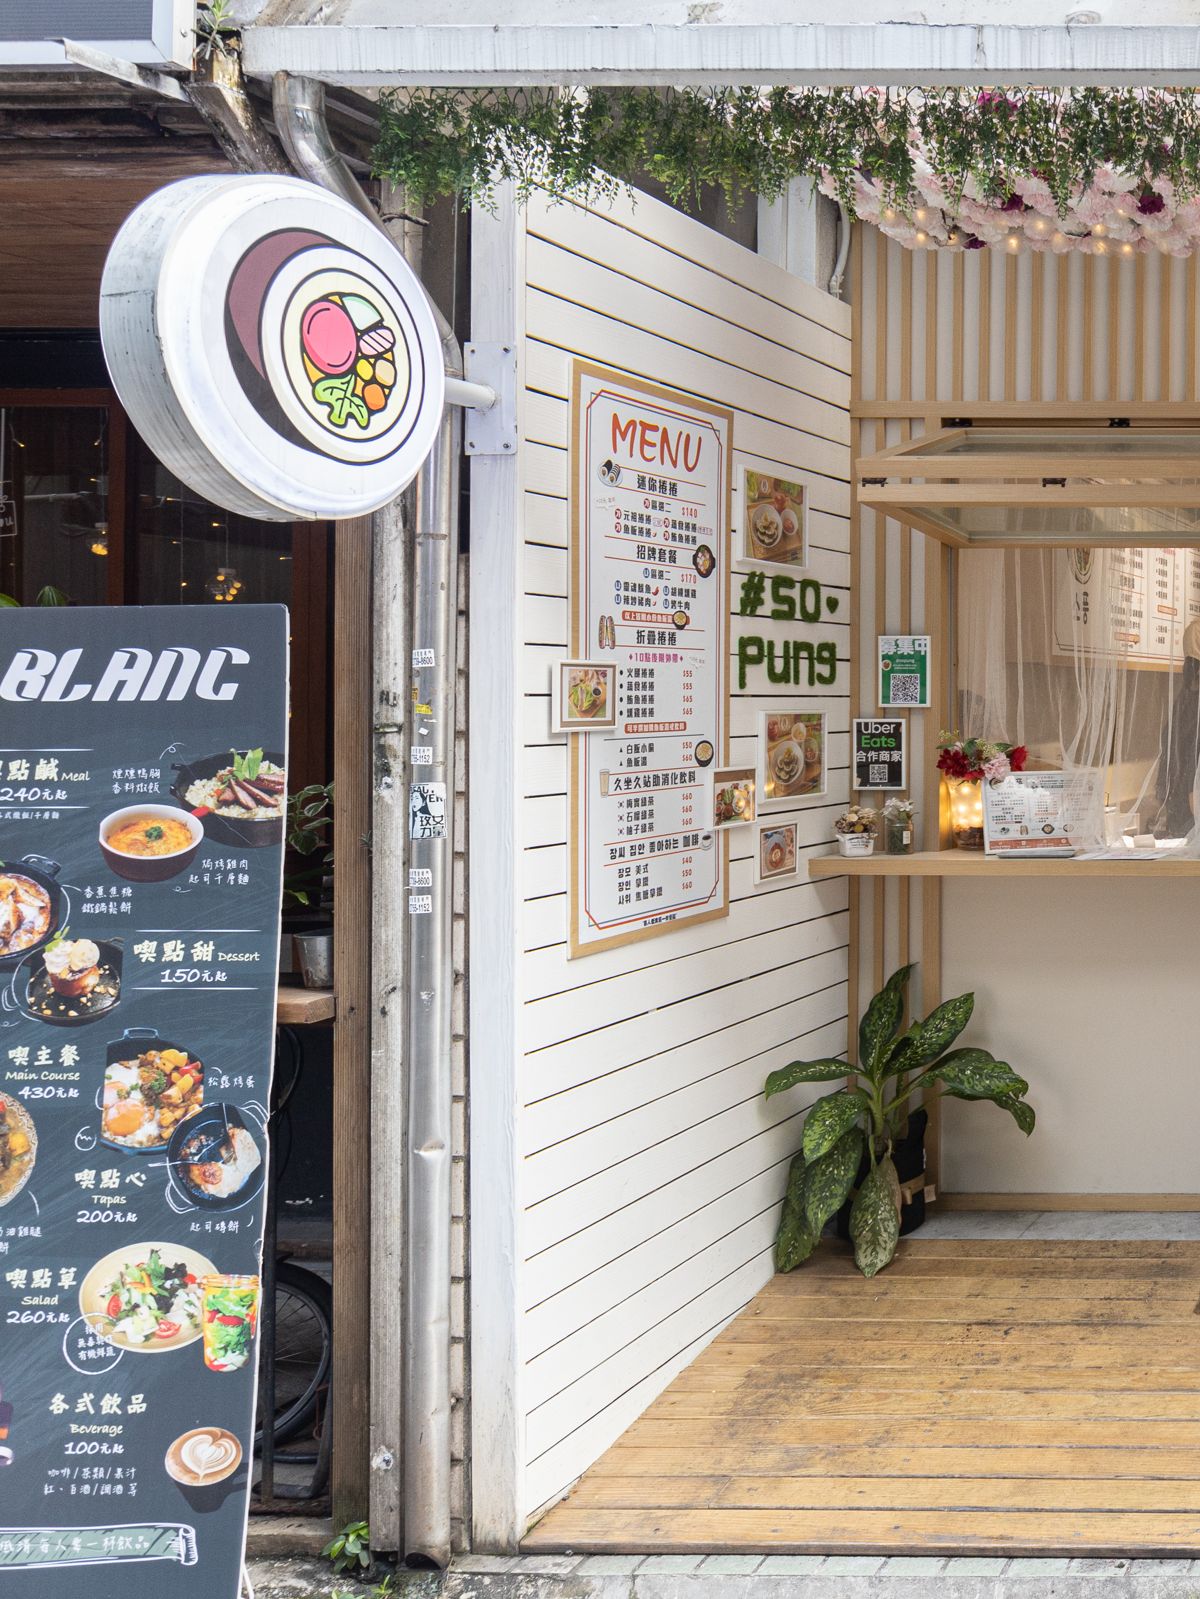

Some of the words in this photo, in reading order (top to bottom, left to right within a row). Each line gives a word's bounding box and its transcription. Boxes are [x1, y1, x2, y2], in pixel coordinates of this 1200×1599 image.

[611, 412, 702, 473] MENU
[637, 474, 678, 497] 迷你捲捲
[637, 544, 677, 564] 招牌套餐
[636, 629, 677, 646] 折疊捲捲
[861, 722, 896, 734] Uber
[861, 735, 897, 748] Eats
[856, 750, 902, 762] 合作商家
[0, 758, 59, 782] 點鹹
[61, 771, 91, 782] Meal
[614, 770, 696, 791] 久坐久站助消化飲料
[635, 863, 649, 876] 美式
[133, 940, 215, 963] 喫點甜
[217, 951, 260, 962] Dessert
[160, 968, 228, 983] 150元起
[8, 1044, 81, 1067] 喫主餐
[5, 1068, 39, 1081] Main
[40, 1070, 81, 1081] Course
[17, 1086, 80, 1100] 430元起
[74, 1168, 148, 1190] 喫點心
[91, 1195, 127, 1206] Tapas
[76, 1210, 138, 1223] 200元起
[5, 1266, 78, 1290] 喫點草
[5, 1310, 70, 1324] 260元起
[48, 1392, 148, 1415] 各式飲品
[69, 1423, 124, 1437] Beverage
[64, 1441, 125, 1455] 100元起
